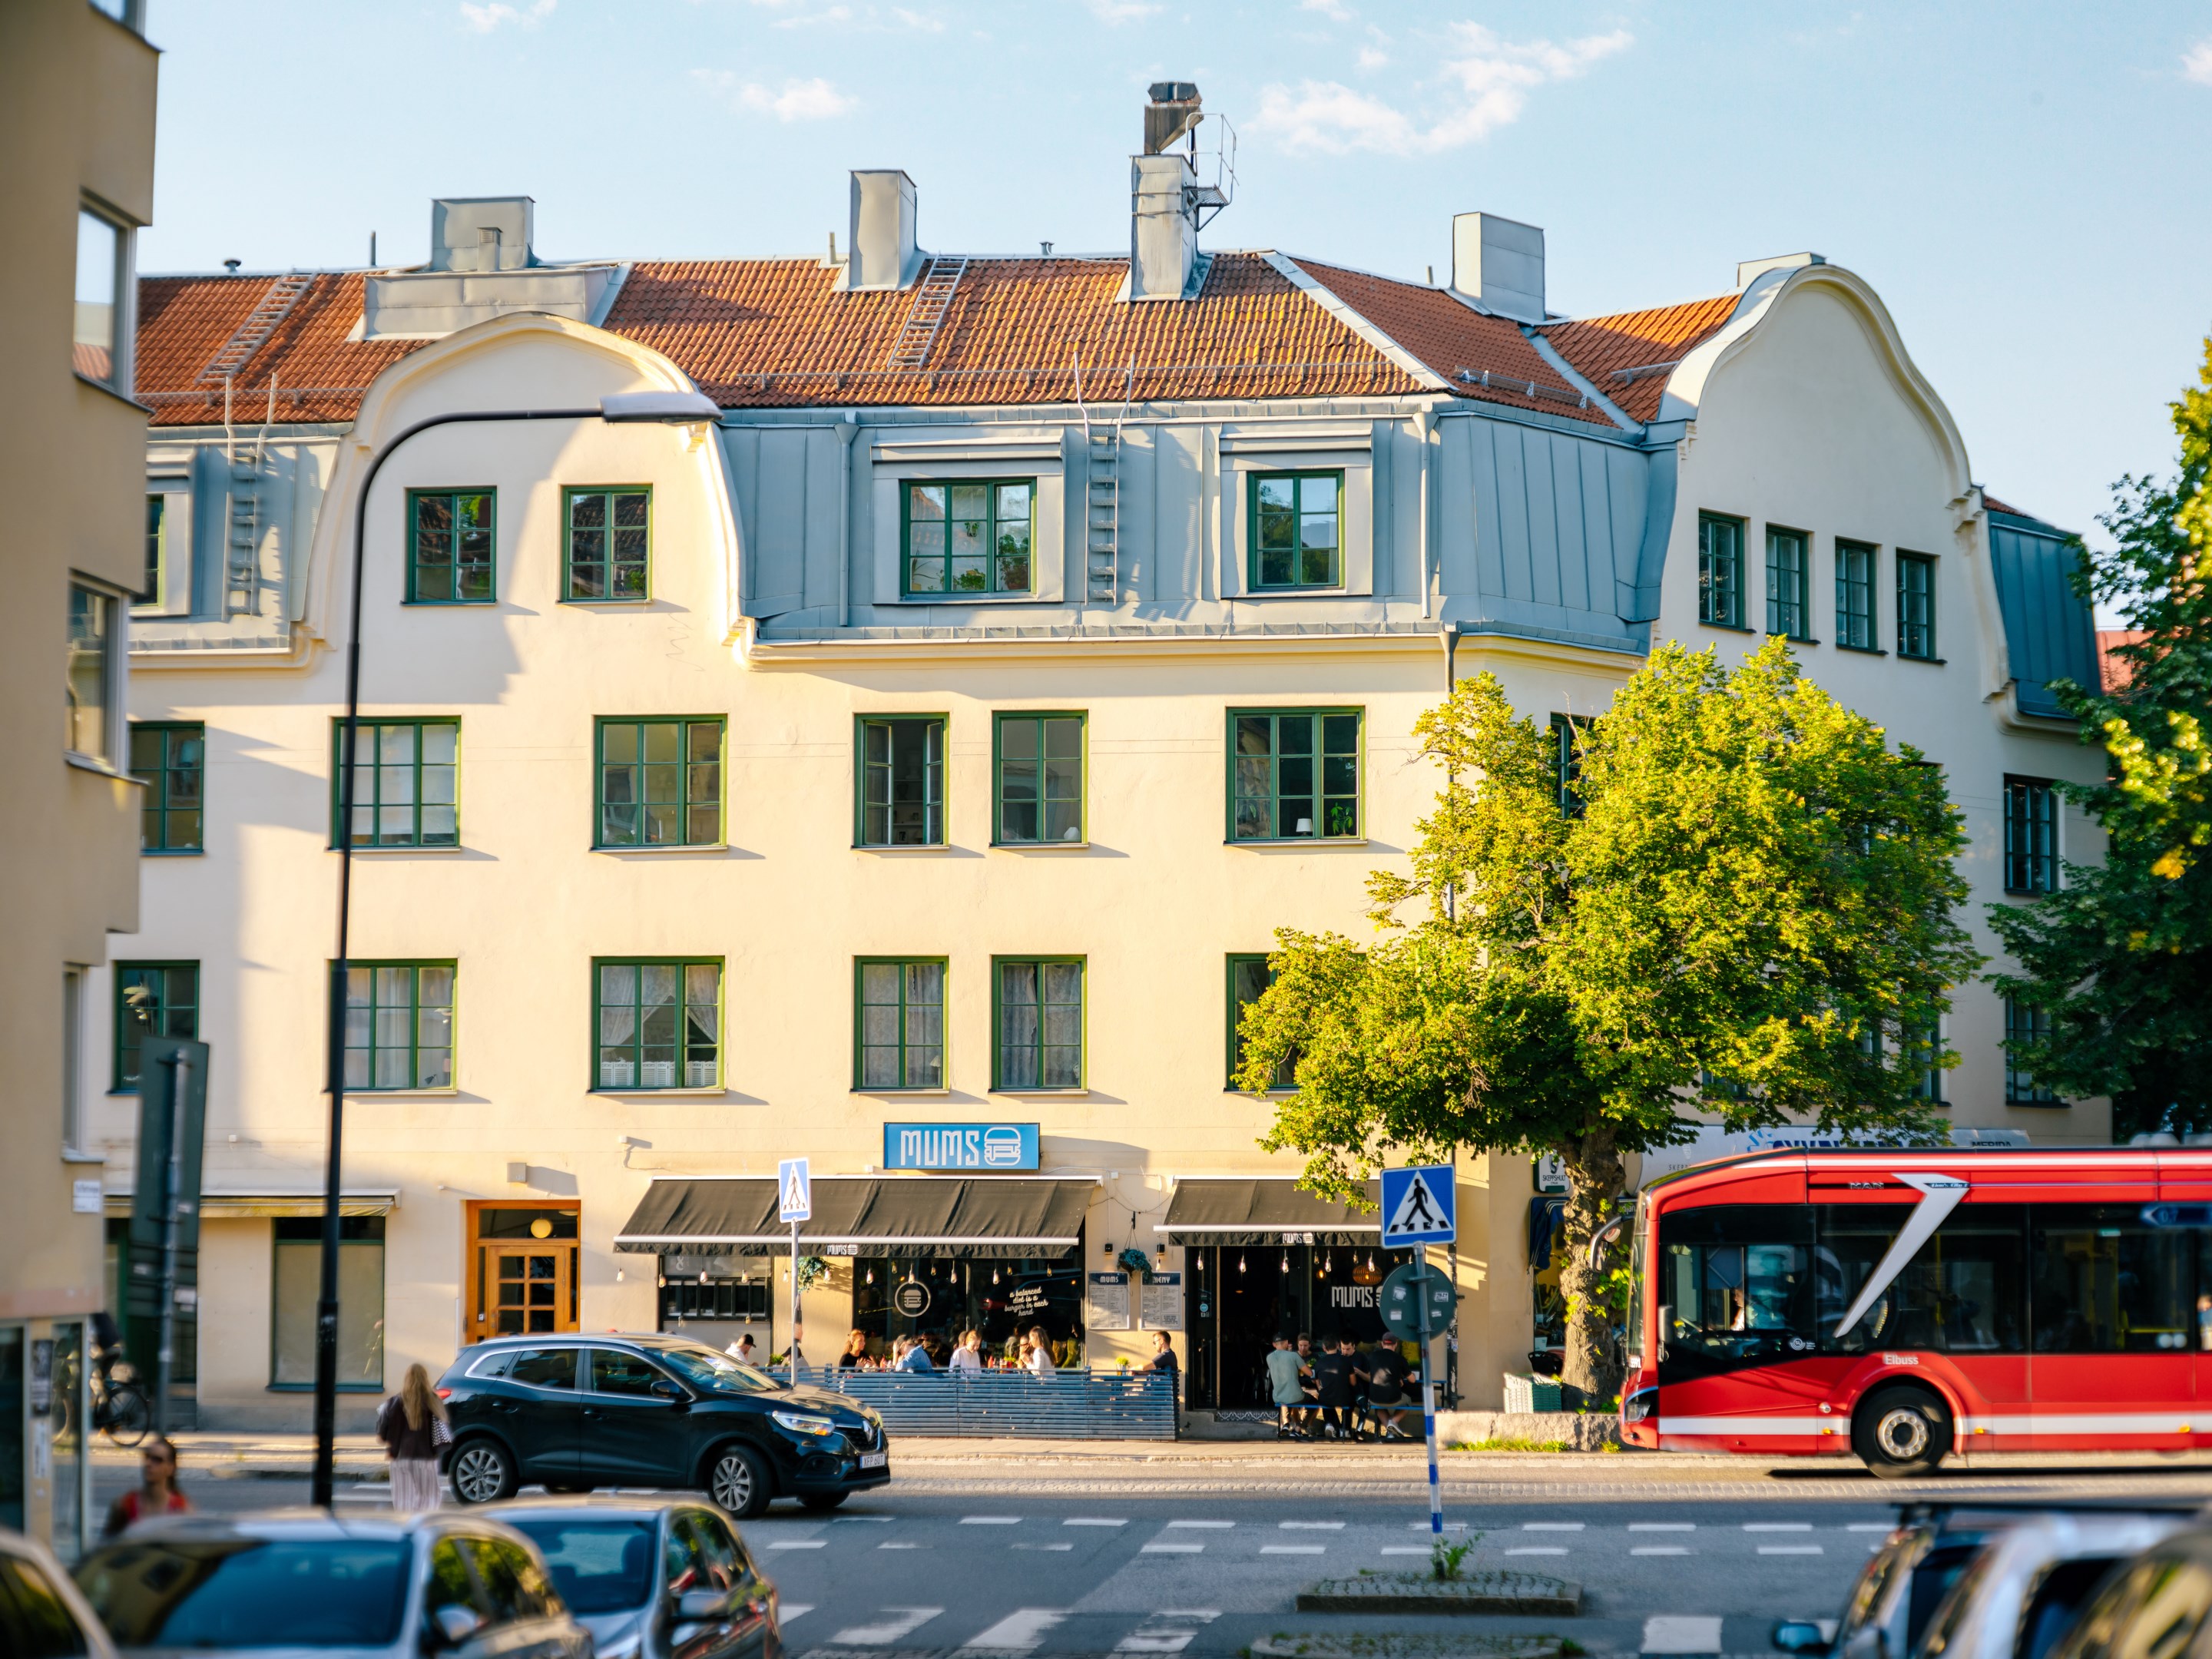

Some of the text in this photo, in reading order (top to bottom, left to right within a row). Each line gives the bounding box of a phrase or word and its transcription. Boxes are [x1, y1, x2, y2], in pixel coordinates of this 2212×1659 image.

[900, 1130, 979, 1166] MUMS
[1282, 1232, 1303, 1244] MUMS
[826, 1244, 847, 1256] MUMS
[1015, 1286, 1042, 1296] balanced
[1331, 1286, 1373, 1307] MUMS
[1004, 1304, 1025, 1313] burger
[1033, 1298, 1048, 1308] each
[1884, 1354, 1919, 1366] Elbuss
